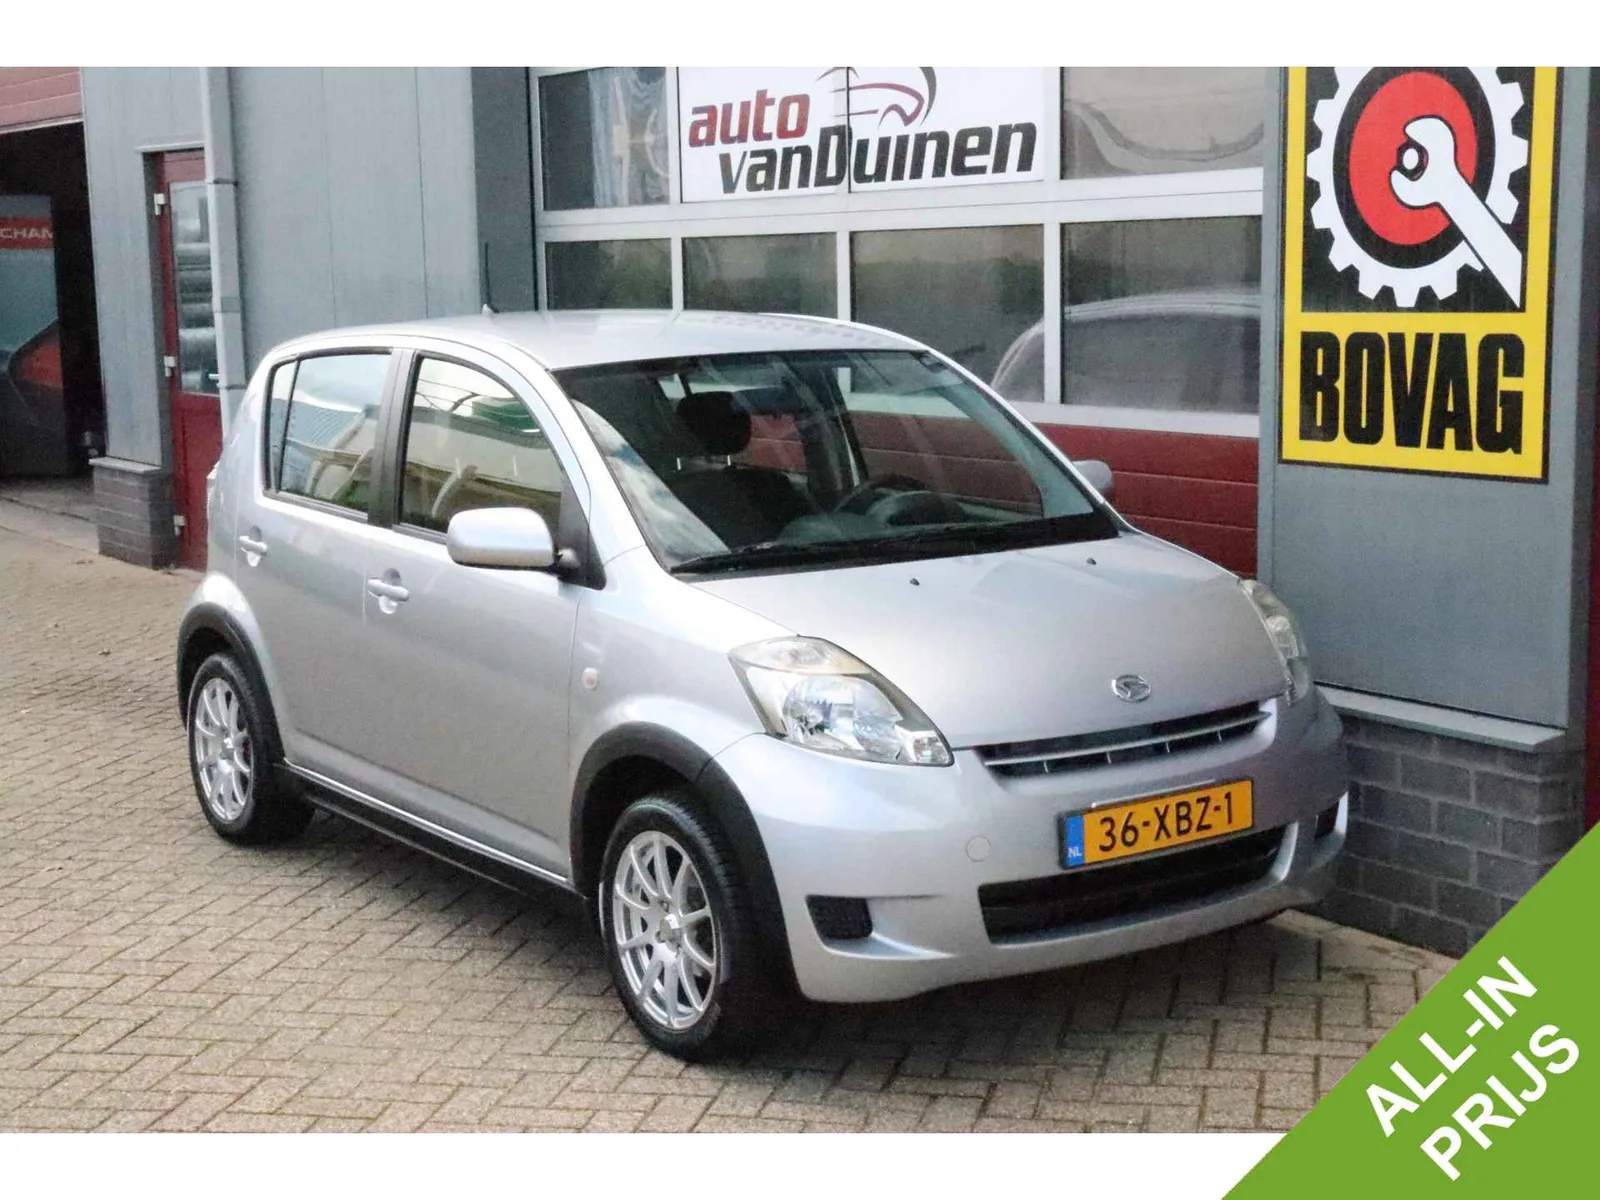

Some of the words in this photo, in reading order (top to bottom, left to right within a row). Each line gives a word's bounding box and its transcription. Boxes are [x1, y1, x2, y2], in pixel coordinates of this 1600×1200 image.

[688, 89, 810, 148] auto
[718, 121, 1037, 194] vanDuinen
[1299, 331, 1525, 455] BOVAG
[1099, 792, 1233, 852] 36-XBZ-1
[1067, 847, 1082, 859] NL
